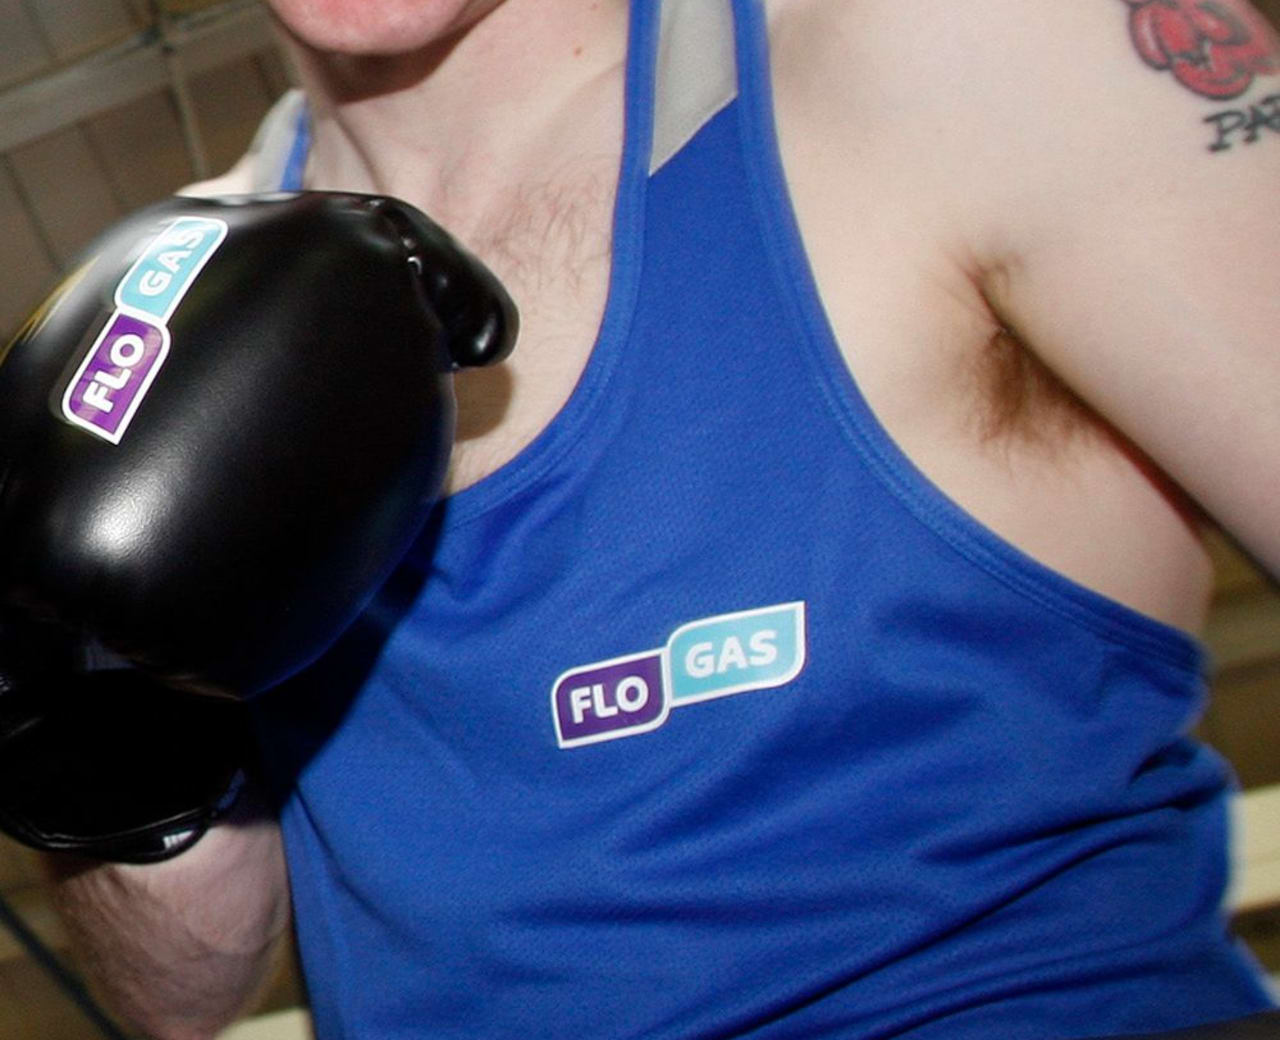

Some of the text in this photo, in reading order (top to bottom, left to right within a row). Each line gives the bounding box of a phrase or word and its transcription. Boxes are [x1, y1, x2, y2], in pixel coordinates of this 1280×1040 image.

[83, 229, 204, 413] FLO GAS
[569, 629, 777, 724] FLO GAS
